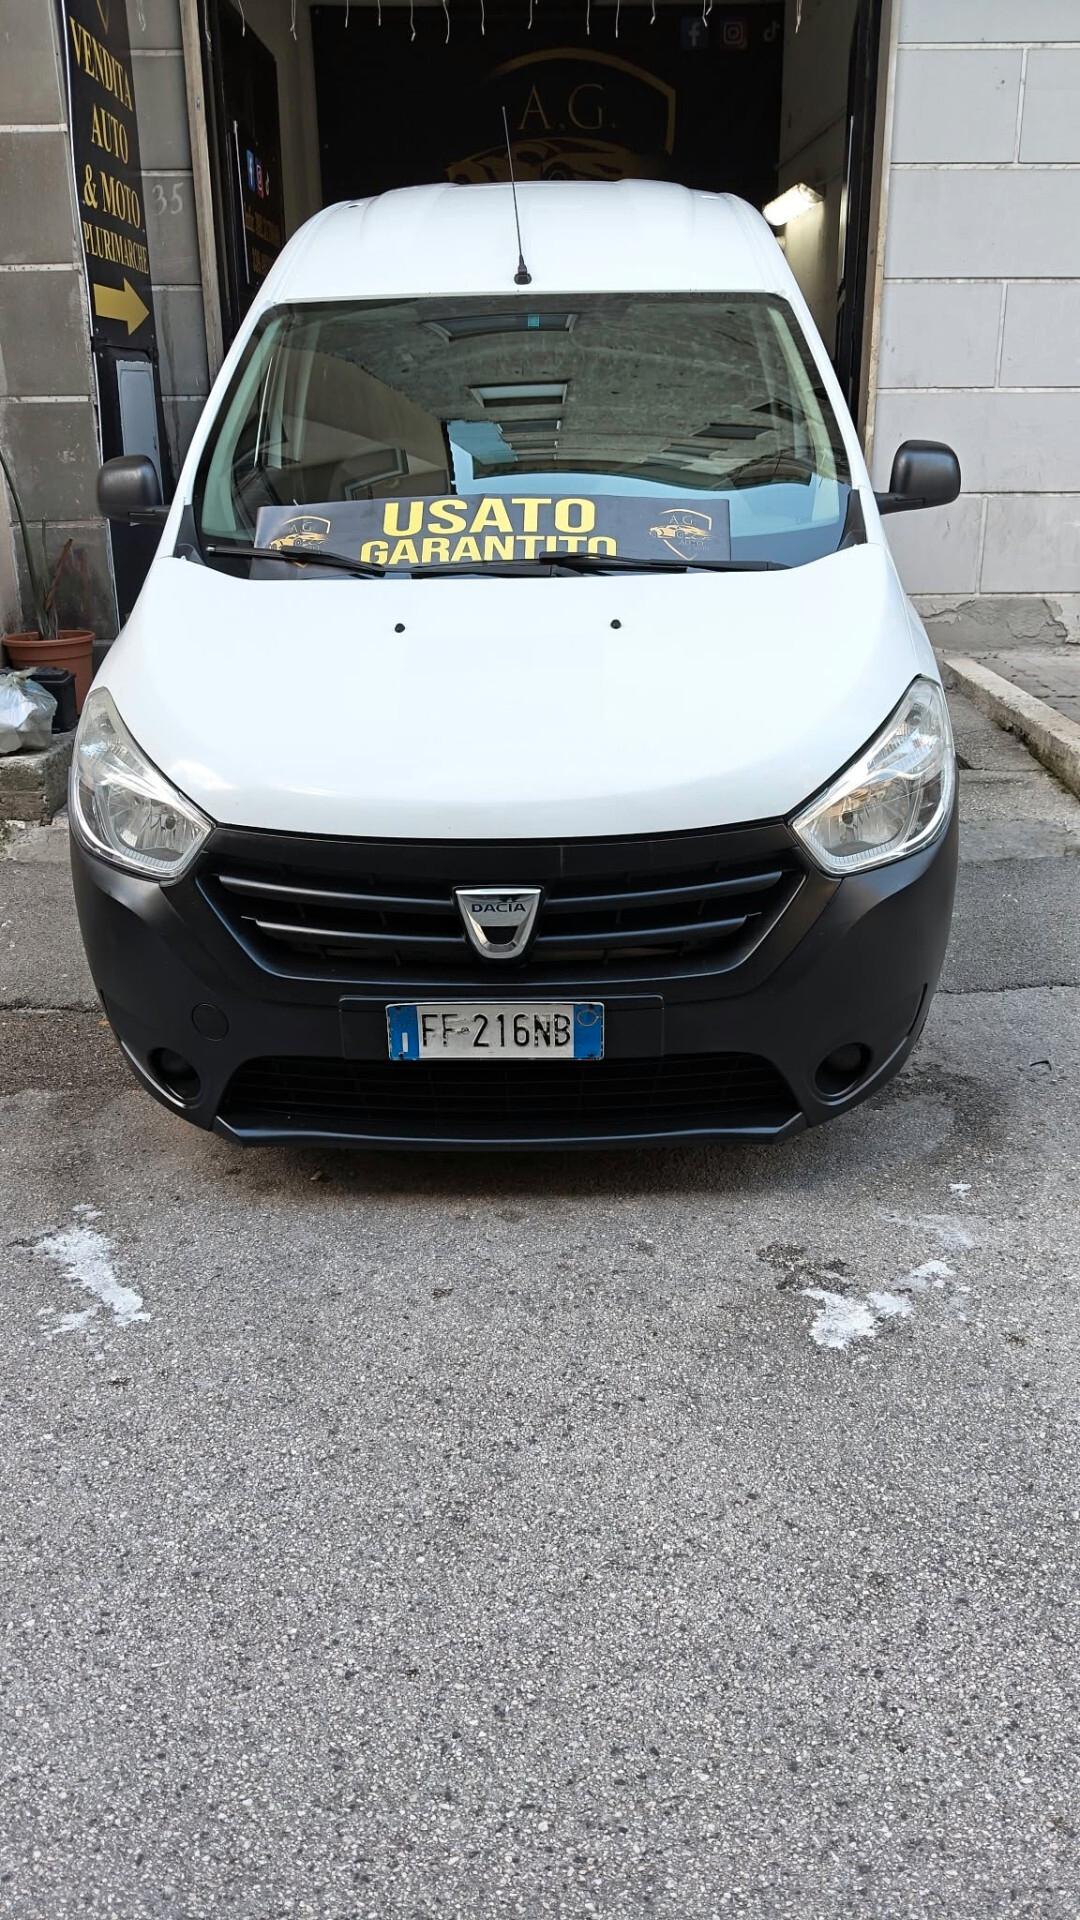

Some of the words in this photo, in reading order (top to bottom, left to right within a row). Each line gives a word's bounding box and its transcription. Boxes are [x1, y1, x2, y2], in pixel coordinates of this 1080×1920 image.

[69, 16, 133, 112] VENDITA
[91, 104, 128, 164] AUTO
[83, 164, 98, 209] &
[99, 171, 140, 228] MOTO
[151, 182, 184, 216] 35
[82, 221, 149, 274] PLURIMARCHE
[383, 497, 596, 537] USATO
[360, 535, 617, 565] GARANTITO
[471, 902, 527, 913] DACIA
